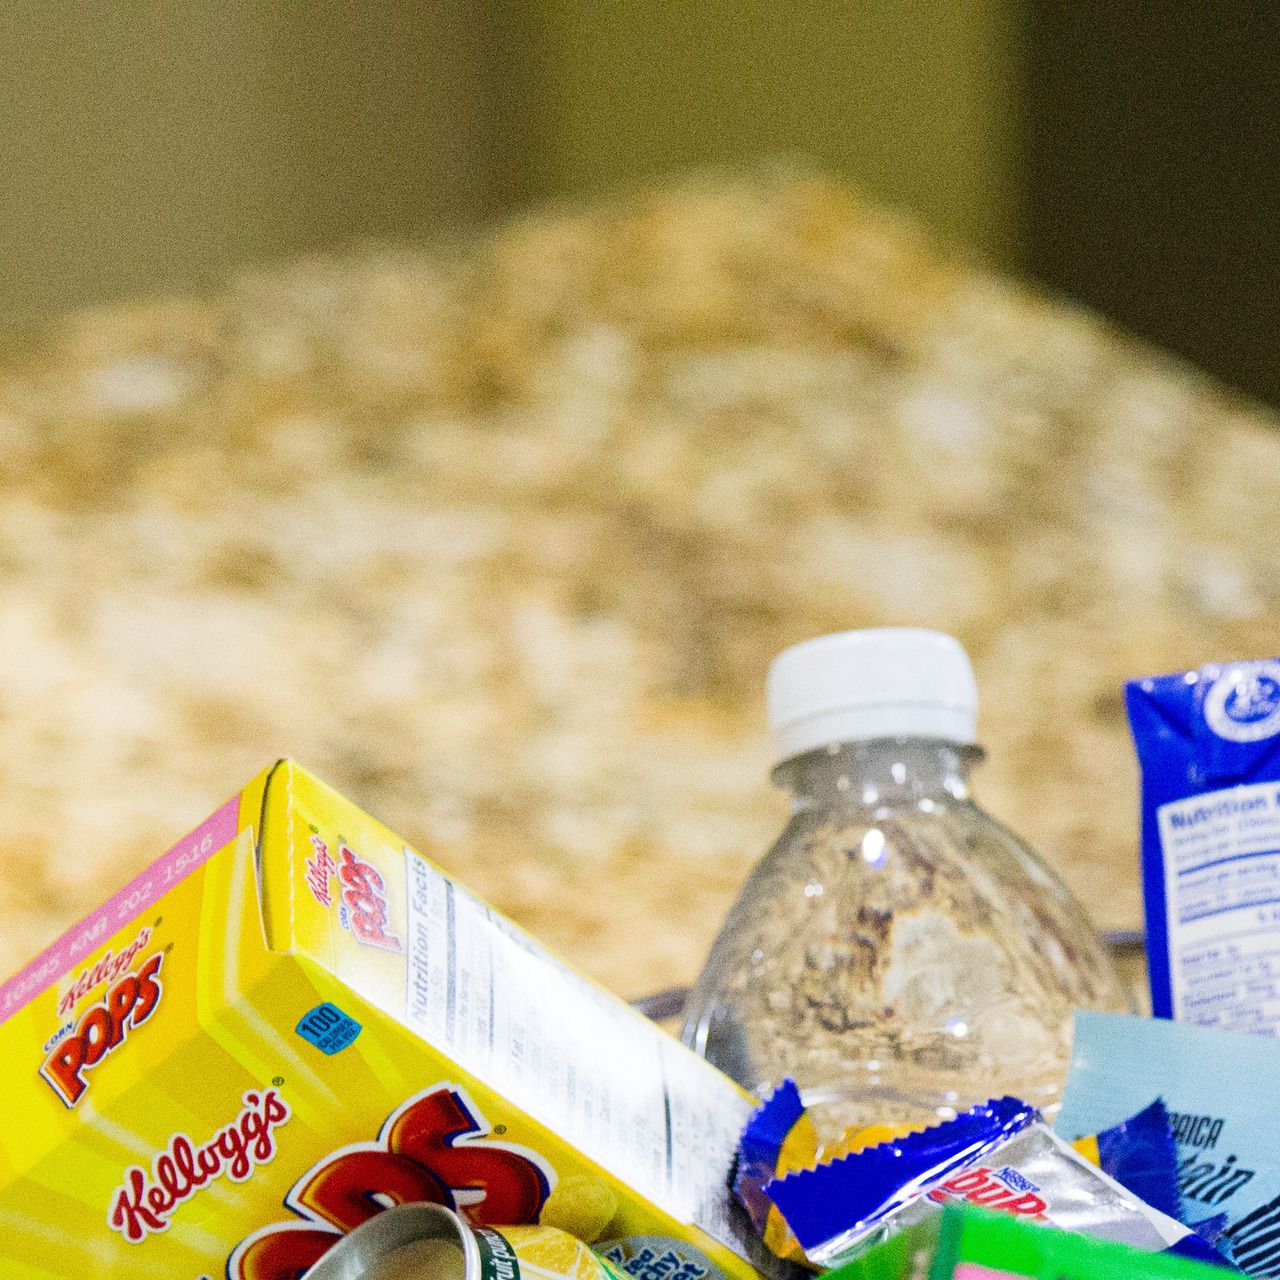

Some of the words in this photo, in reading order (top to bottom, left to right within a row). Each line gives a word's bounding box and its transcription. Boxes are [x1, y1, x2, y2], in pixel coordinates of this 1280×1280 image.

[1170, 794, 1268, 831] Nutrition
[118, 881, 154, 914] 202
[305, 834, 335, 908] Kellogg's
[337, 844, 404, 954] POPS
[410, 857, 429, 917] Facts
[60, 927, 152, 1015] Kellogg's
[410, 926, 430, 1021] Nutrition
[39, 950, 165, 1110] POPS
[44, 1020, 75, 1053] CORN
[299, 1000, 342, 1044] 100
[110, 1090, 288, 1240] Kellogg's
[477, 1229, 517, 1260] pun
